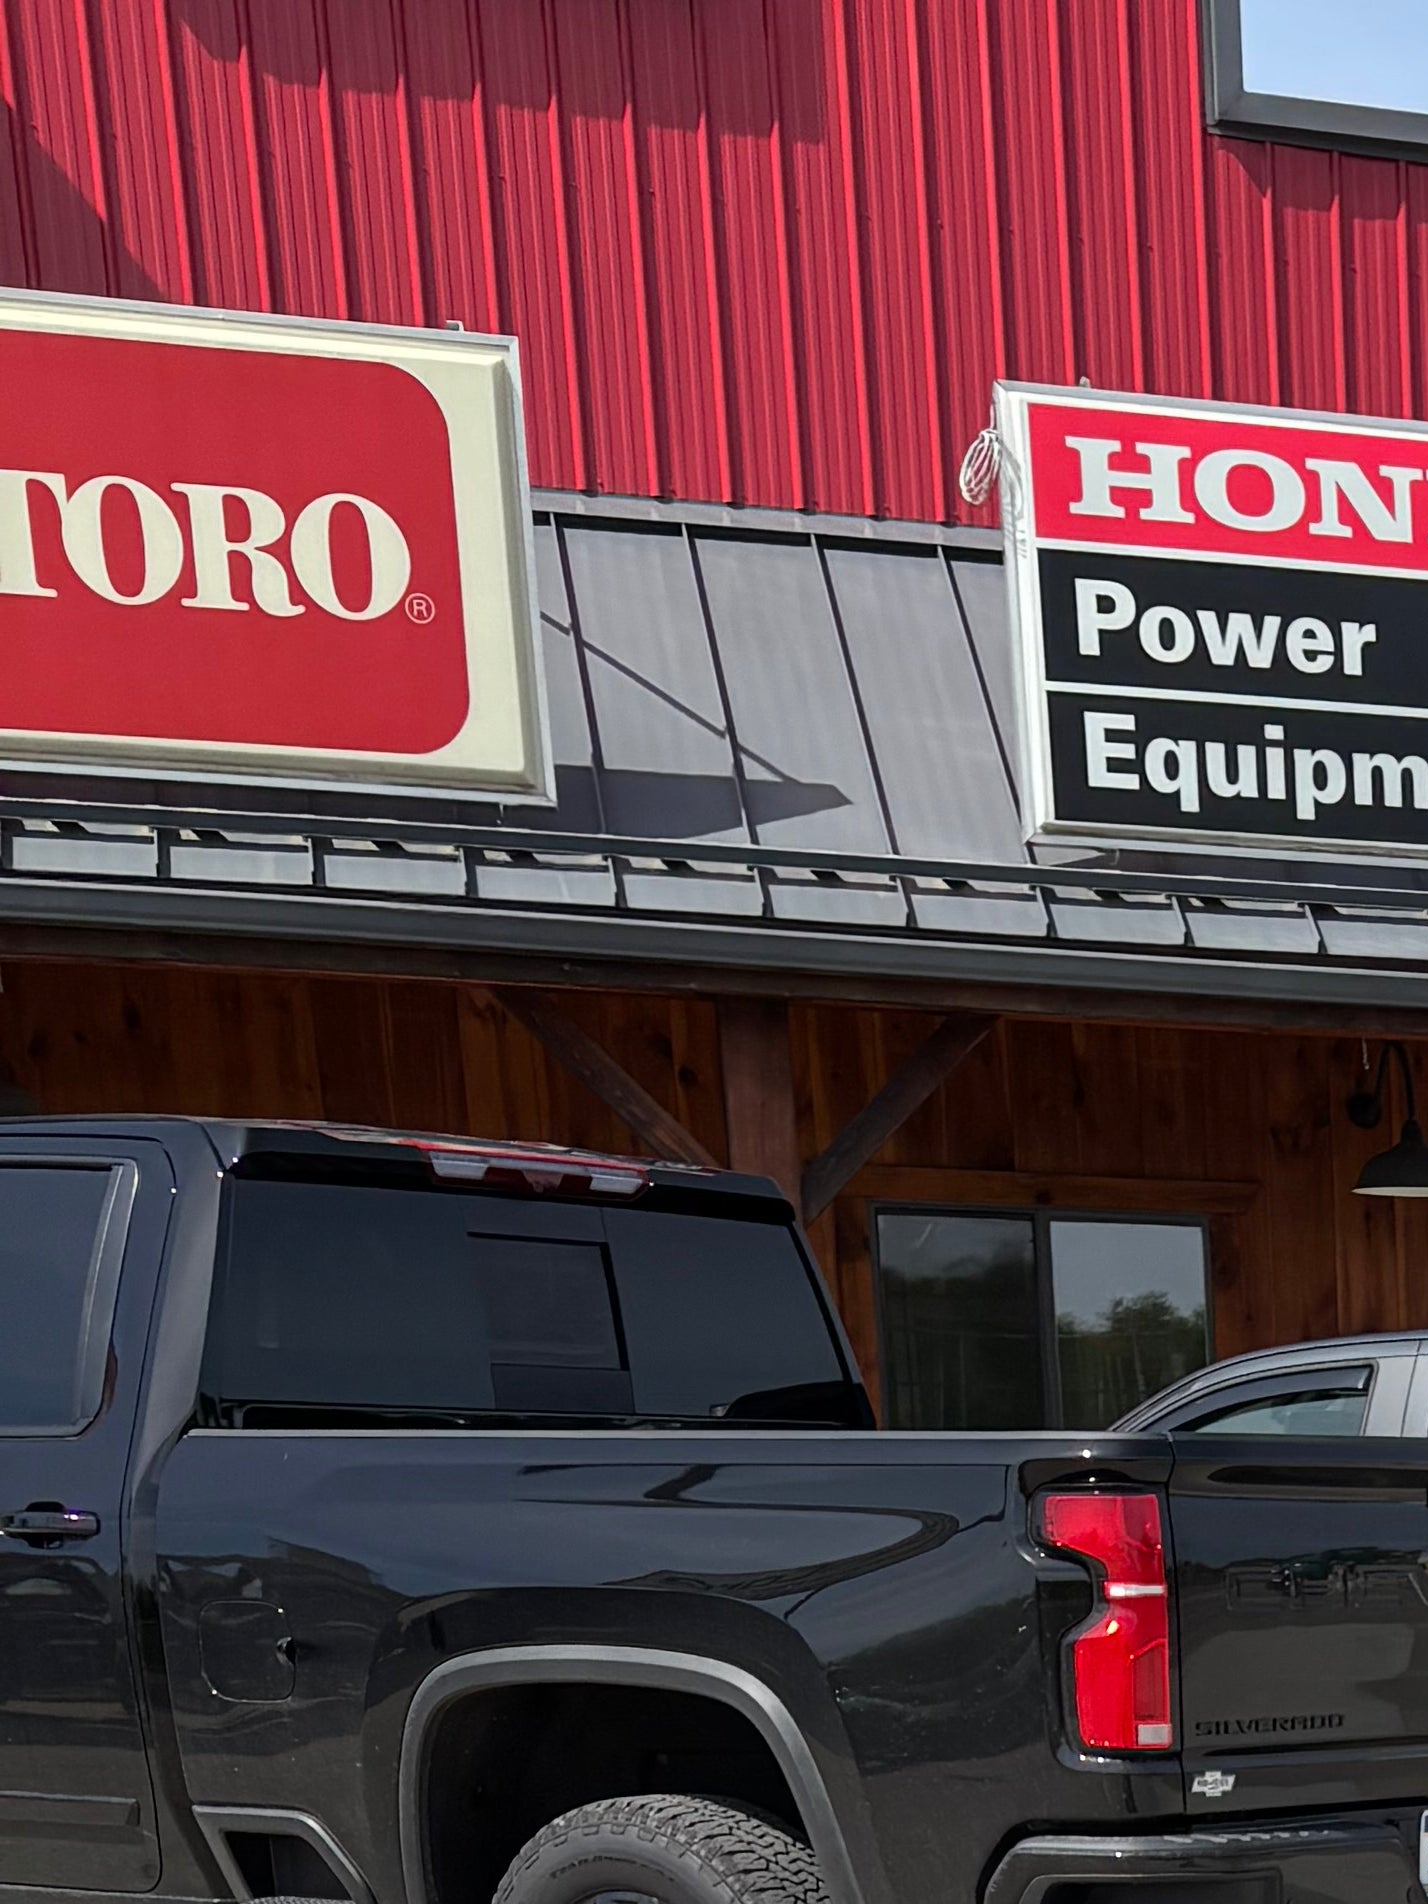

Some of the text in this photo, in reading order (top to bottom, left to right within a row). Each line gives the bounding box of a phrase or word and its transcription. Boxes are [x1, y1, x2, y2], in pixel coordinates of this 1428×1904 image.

[0, 468, 411, 622] TORO
[1073, 576, 1378, 676] Power
[1194, 1712, 1346, 1737] SILVERADO
